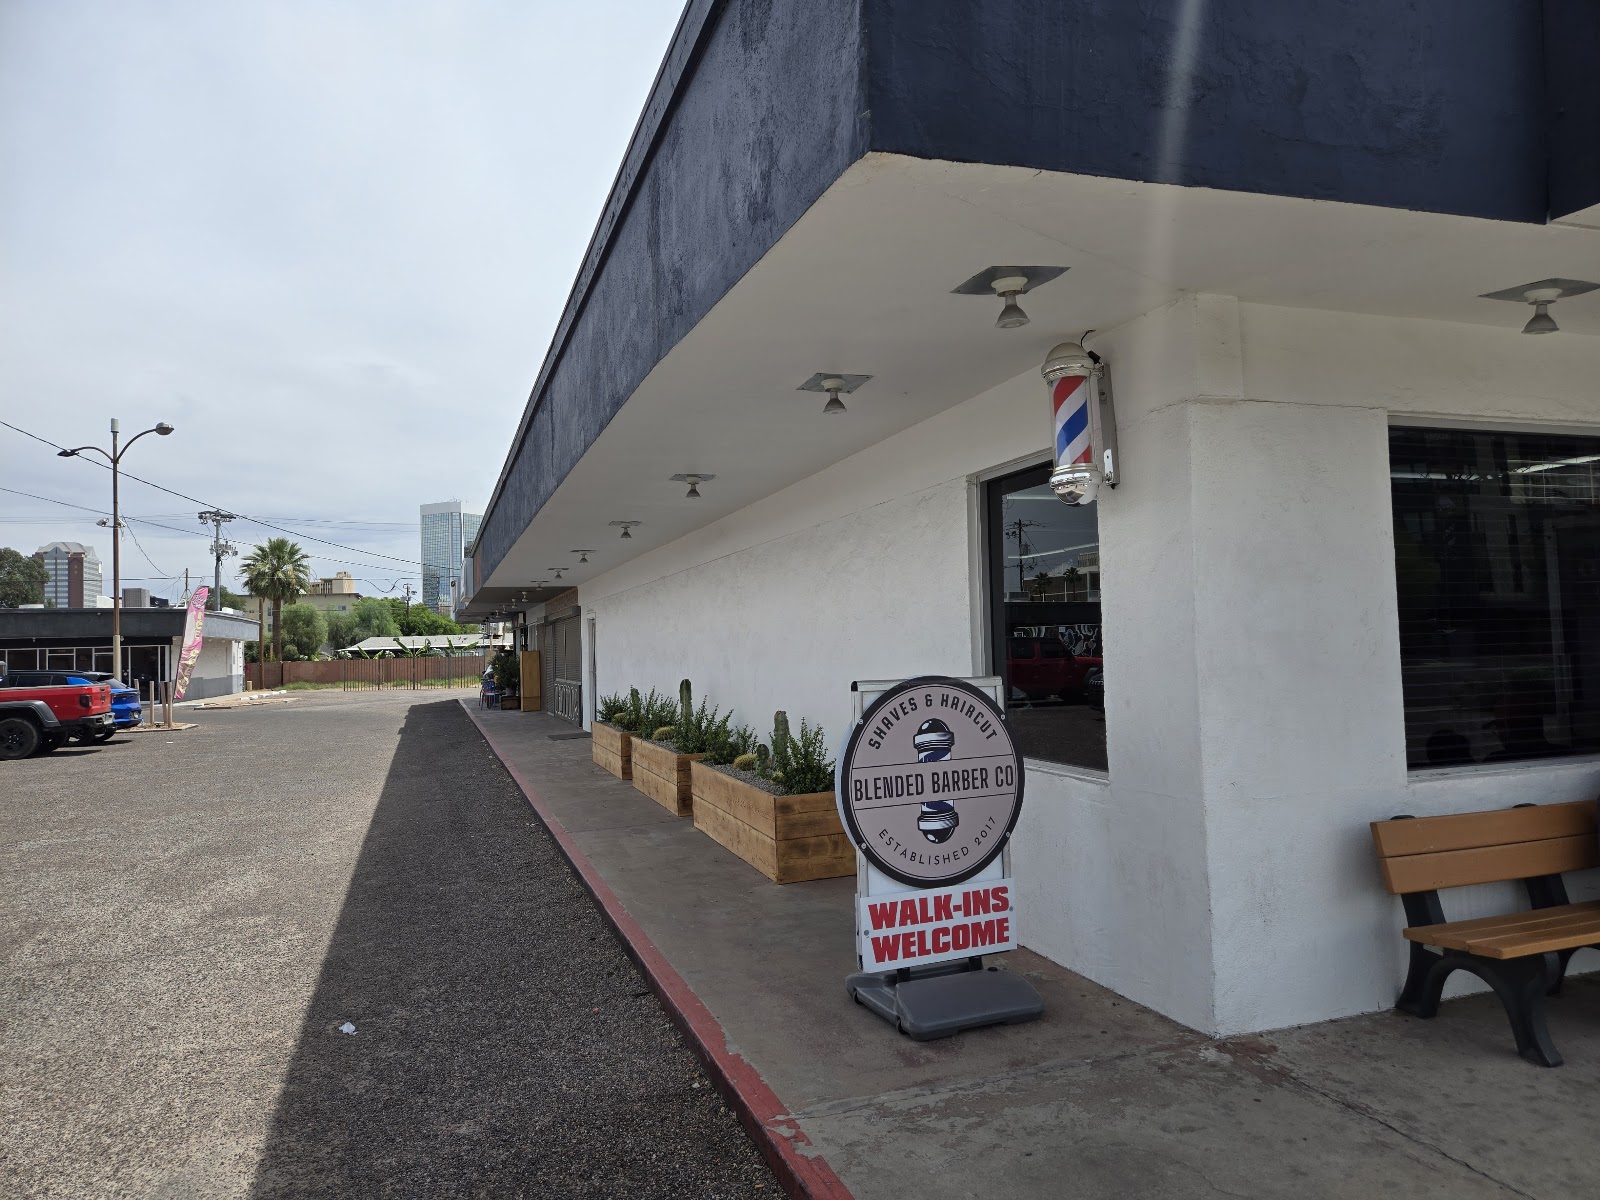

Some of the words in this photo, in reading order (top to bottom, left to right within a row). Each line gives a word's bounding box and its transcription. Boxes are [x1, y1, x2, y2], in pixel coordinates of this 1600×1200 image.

[868, 693, 919, 750] SHAVES
[925, 693, 933, 707] &
[940, 693, 998, 741] HAIRCUT
[854, 773, 924, 802] BLENDED
[931, 766, 989, 794] BARBER
[995, 764, 1014, 787] CO
[878, 828, 970, 865] ESTABLISHED
[974, 815, 997, 847] 2017
[868, 885, 1010, 931] WALK-INS
[871, 917, 1010, 963] WELCOME
